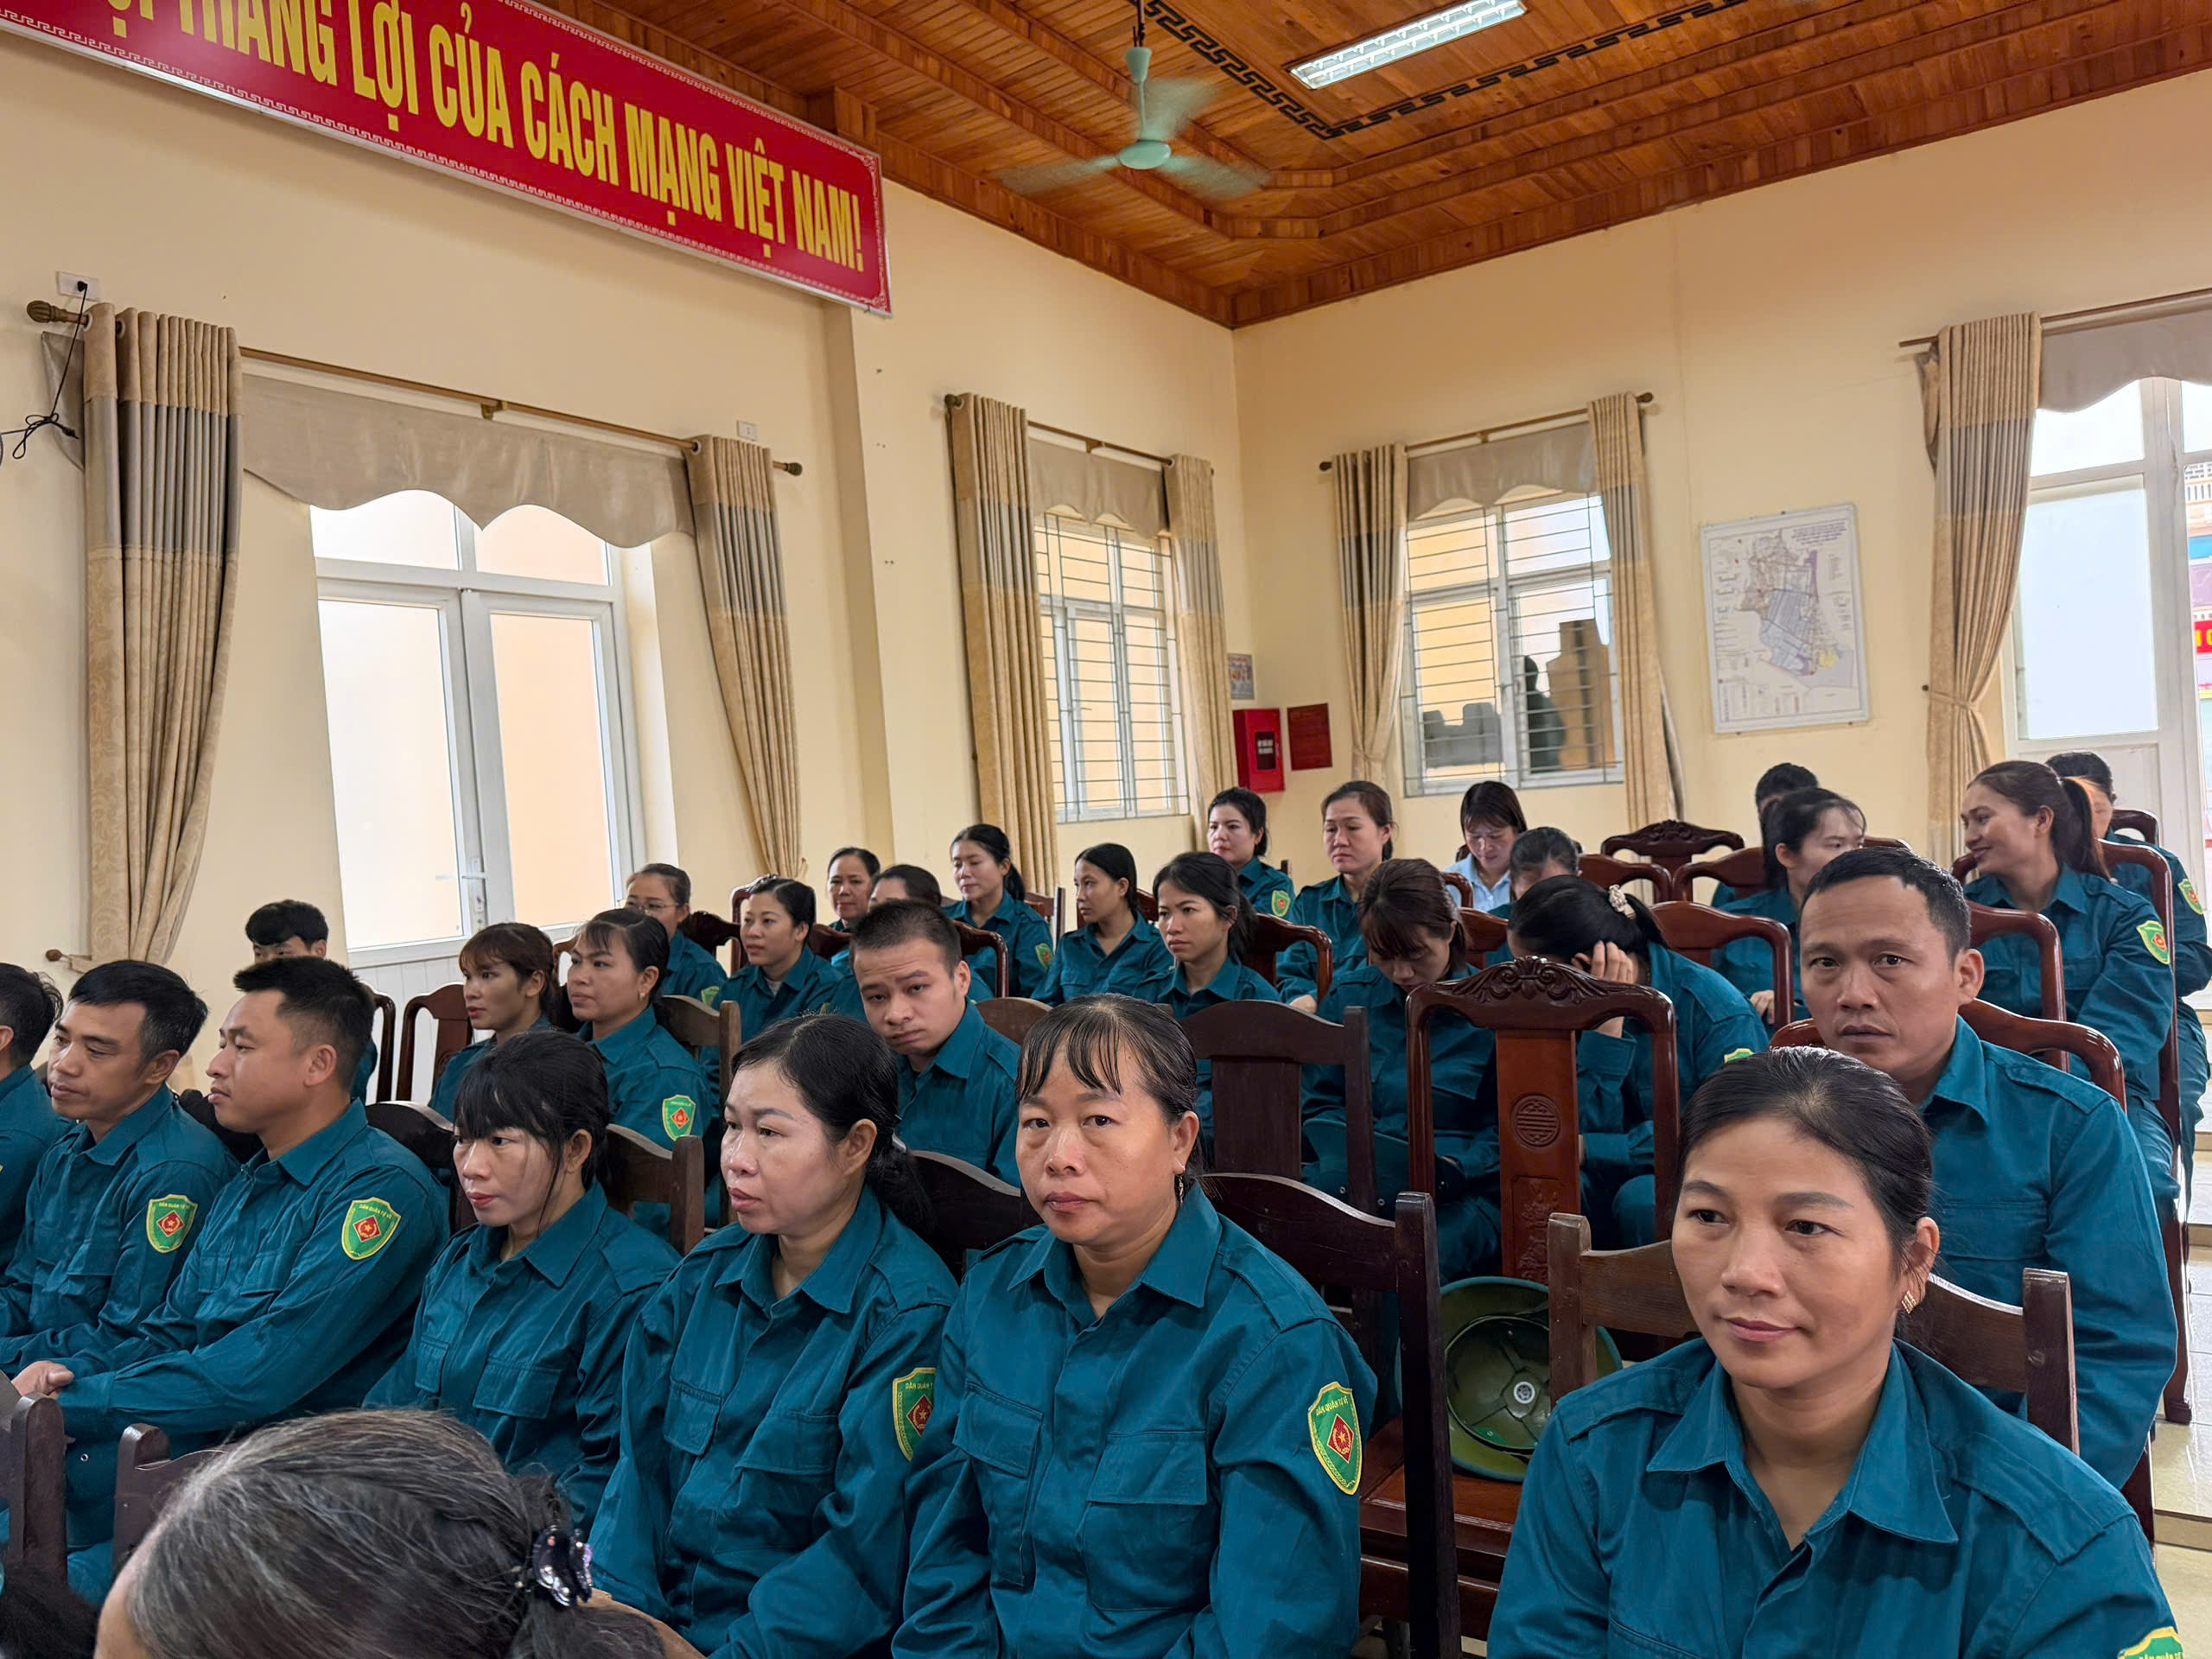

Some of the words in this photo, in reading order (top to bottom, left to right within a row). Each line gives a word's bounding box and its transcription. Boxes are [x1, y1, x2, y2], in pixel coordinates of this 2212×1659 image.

[347, 0, 419, 132] LỢI
[429, 2, 514, 149] CỦA
[520, 52, 620, 186] CÁCH
[625, 102, 722, 226] MẠNG
[725, 137, 786, 258] VIỆT
[791, 169, 864, 272] NAM!
